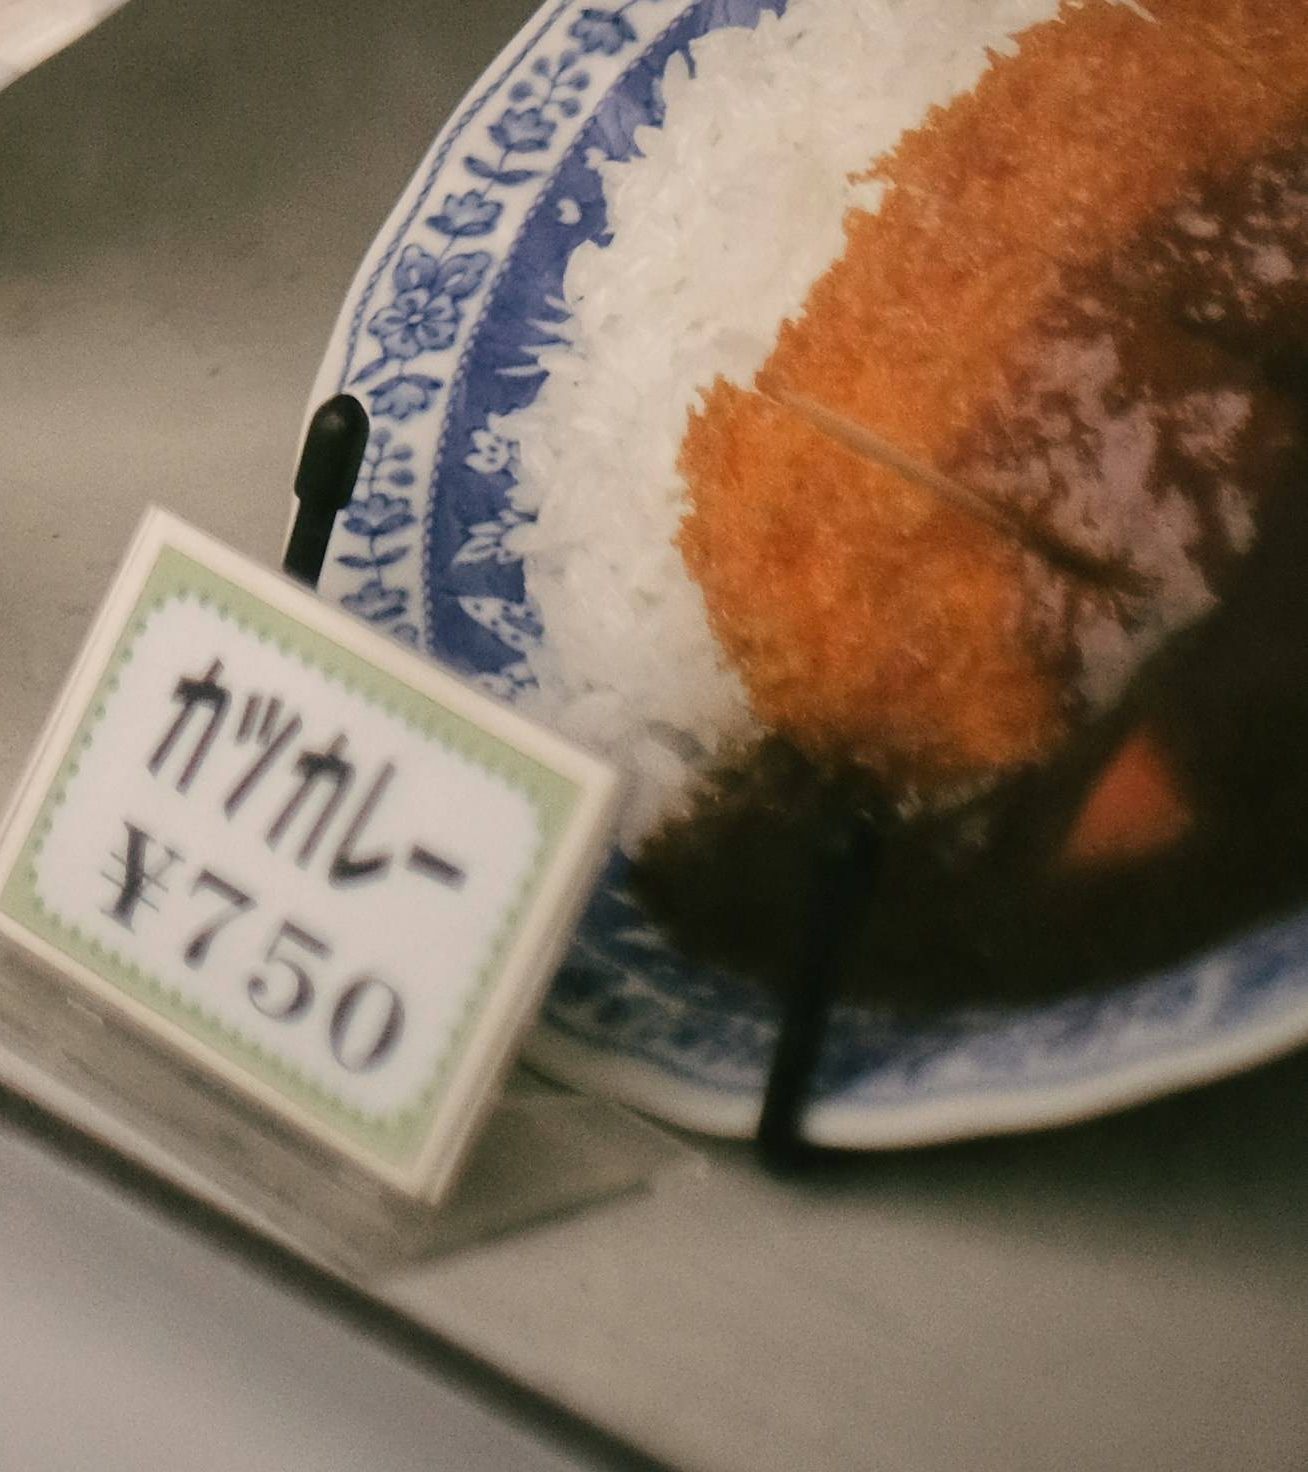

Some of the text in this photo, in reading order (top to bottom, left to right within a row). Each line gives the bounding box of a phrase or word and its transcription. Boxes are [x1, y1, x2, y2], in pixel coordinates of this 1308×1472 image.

[146, 657, 468, 893] カツカレー
[100, 819, 406, 1074] ¥750
